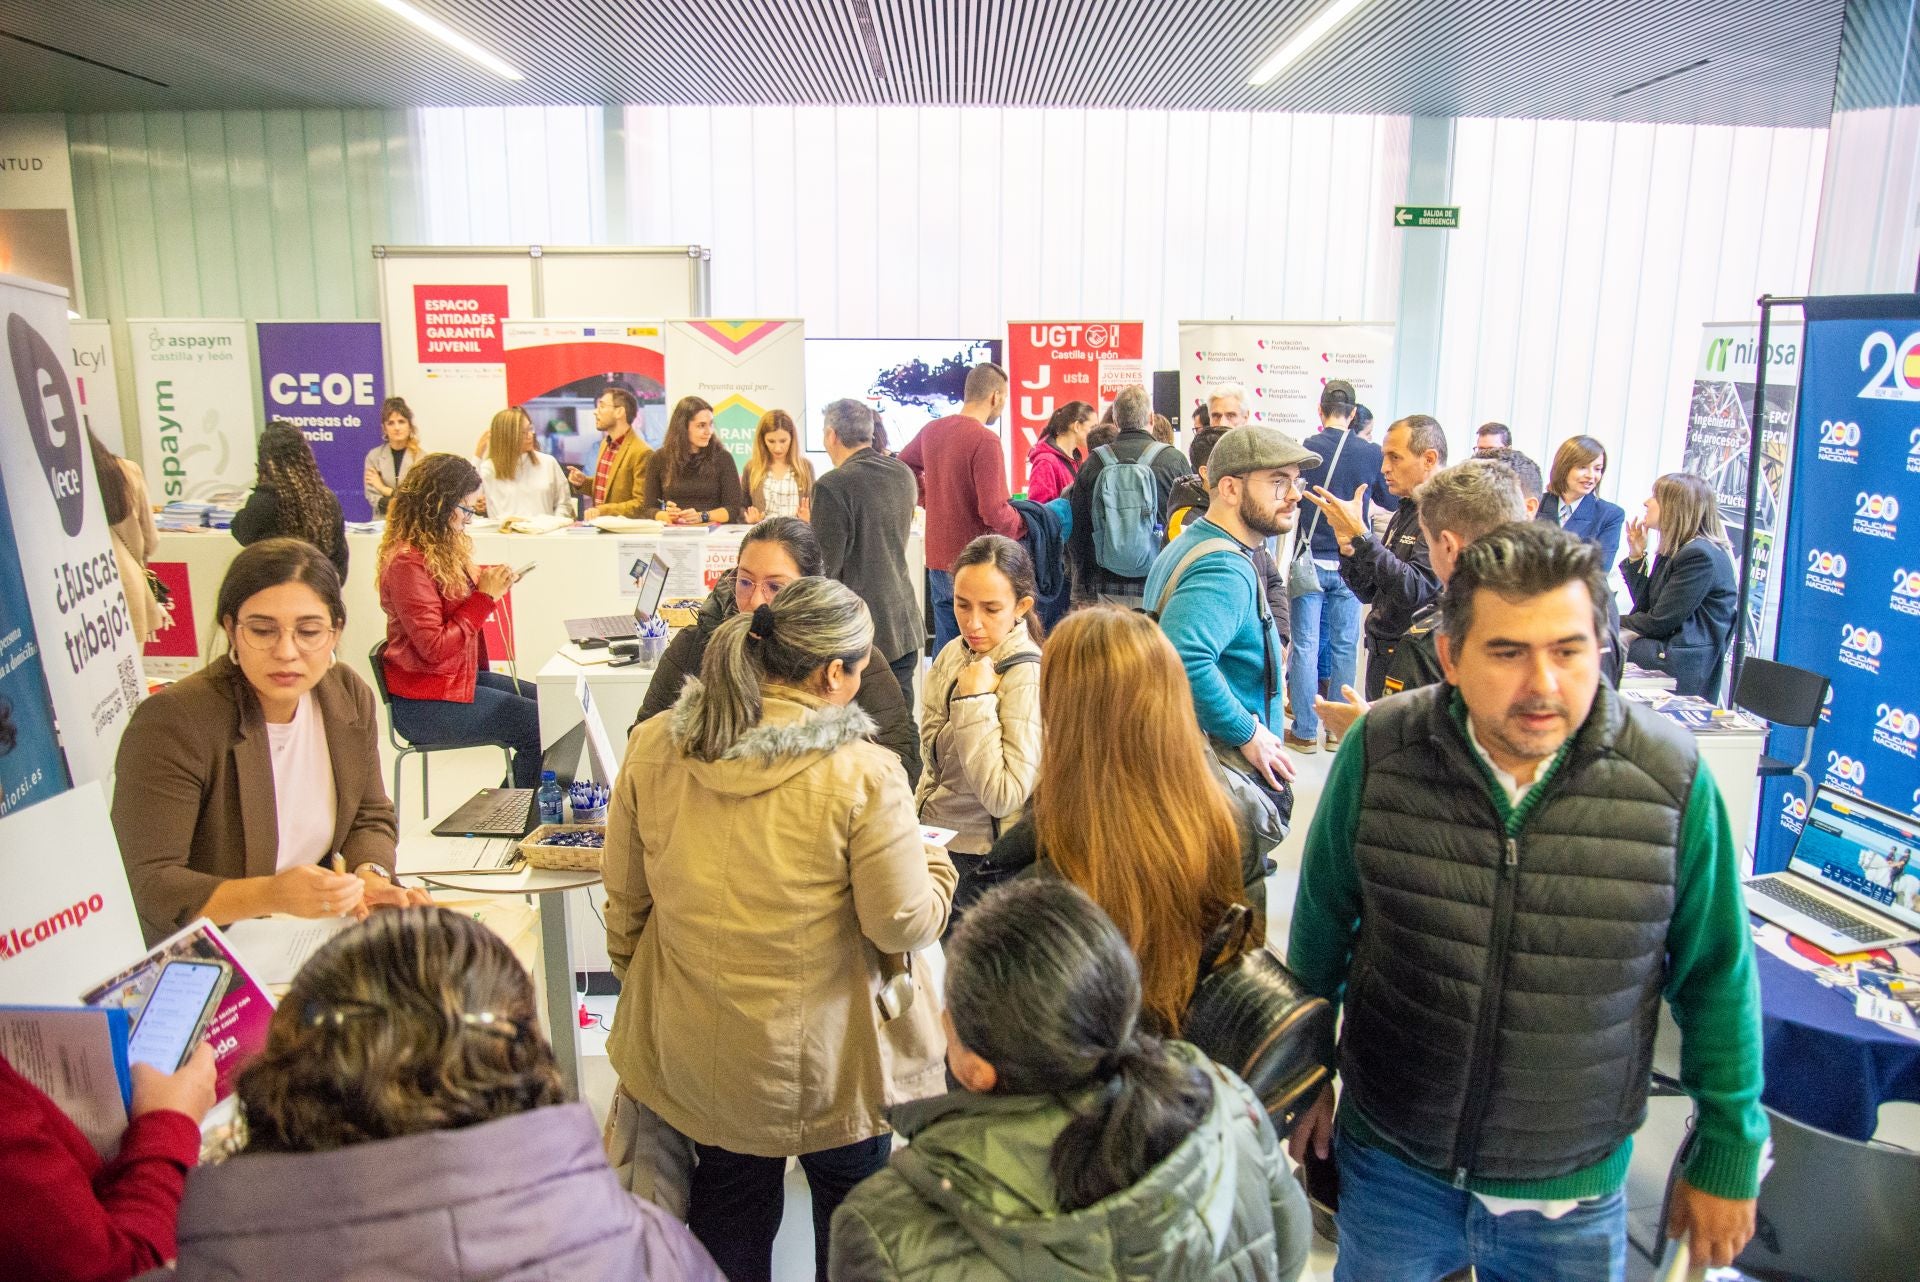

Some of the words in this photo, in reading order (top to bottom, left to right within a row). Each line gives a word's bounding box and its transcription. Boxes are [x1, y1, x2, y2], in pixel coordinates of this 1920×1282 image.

[1423, 209, 1443, 217] SALIDA
[1418, 217, 1456, 226] EMERGENCIA
[425, 299, 479, 311] ESPACIO
[425, 313, 496, 325] ENTIDADES
[426, 324, 496, 339] GARANTÍA
[1030, 325, 1083, 348] UGT
[168, 335, 232, 350] aspaym
[427, 341, 482, 353] JUVENIL
[150, 351, 193, 362] castilla
[197, 353, 204, 363] y
[207, 350, 233, 362] león
[1051, 349, 1086, 360] Castilla
[1087, 351, 1094, 362] y
[1095, 349, 1119, 360] León
[1063, 372, 1090, 384] usta
[269, 373, 375, 406] CEOE
[698, 382, 734, 391] Pregunta
[735, 383, 753, 392] aquí
[342, 414, 362, 428] de
[1694, 413, 1737, 429] Ingeniería
[303, 428, 334, 442] ncia
[1691, 431, 1702, 443] de
[1703, 432, 1741, 448] procesos
[1760, 429, 1788, 444] EPCM
[1819, 419, 1860, 447] 200
[155, 380, 187, 505] spaym
[1818, 453, 1859, 465] NACIONAL
[1854, 491, 1899, 522] 200
[1852, 525, 1896, 540] NACIONAL
[706, 552, 736, 563] JÓVE
[1807, 548, 1848, 578] 200
[54, 549, 119, 615] ¿Buscas
[1805, 580, 1845, 596] NACIONAL
[64, 590, 130, 675] trabajo?
[1840, 623, 1883, 656] 200
[1838, 655, 1880, 675] NACIONAL
[1872, 735, 1917, 759] NACIONAL
[1826, 750, 1865, 786] 200
